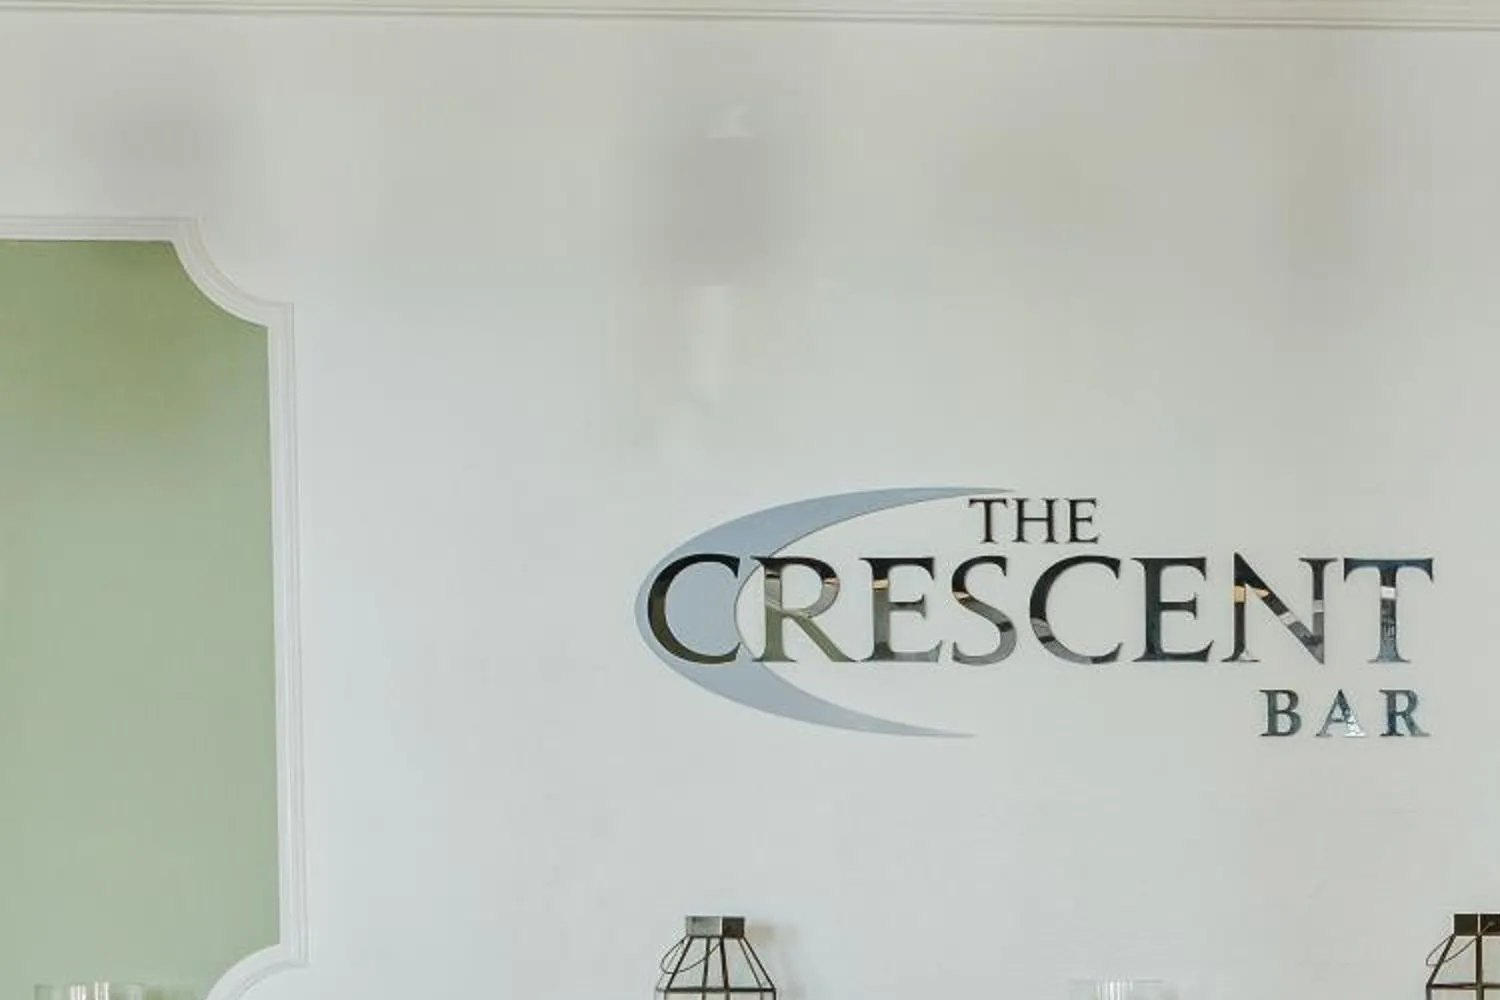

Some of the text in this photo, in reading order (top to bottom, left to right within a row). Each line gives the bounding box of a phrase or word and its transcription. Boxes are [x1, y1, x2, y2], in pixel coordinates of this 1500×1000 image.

[969, 498, 1099, 544] THE
[647, 552, 1435, 665] CRESCENT
[1260, 689, 1431, 738] BAR
